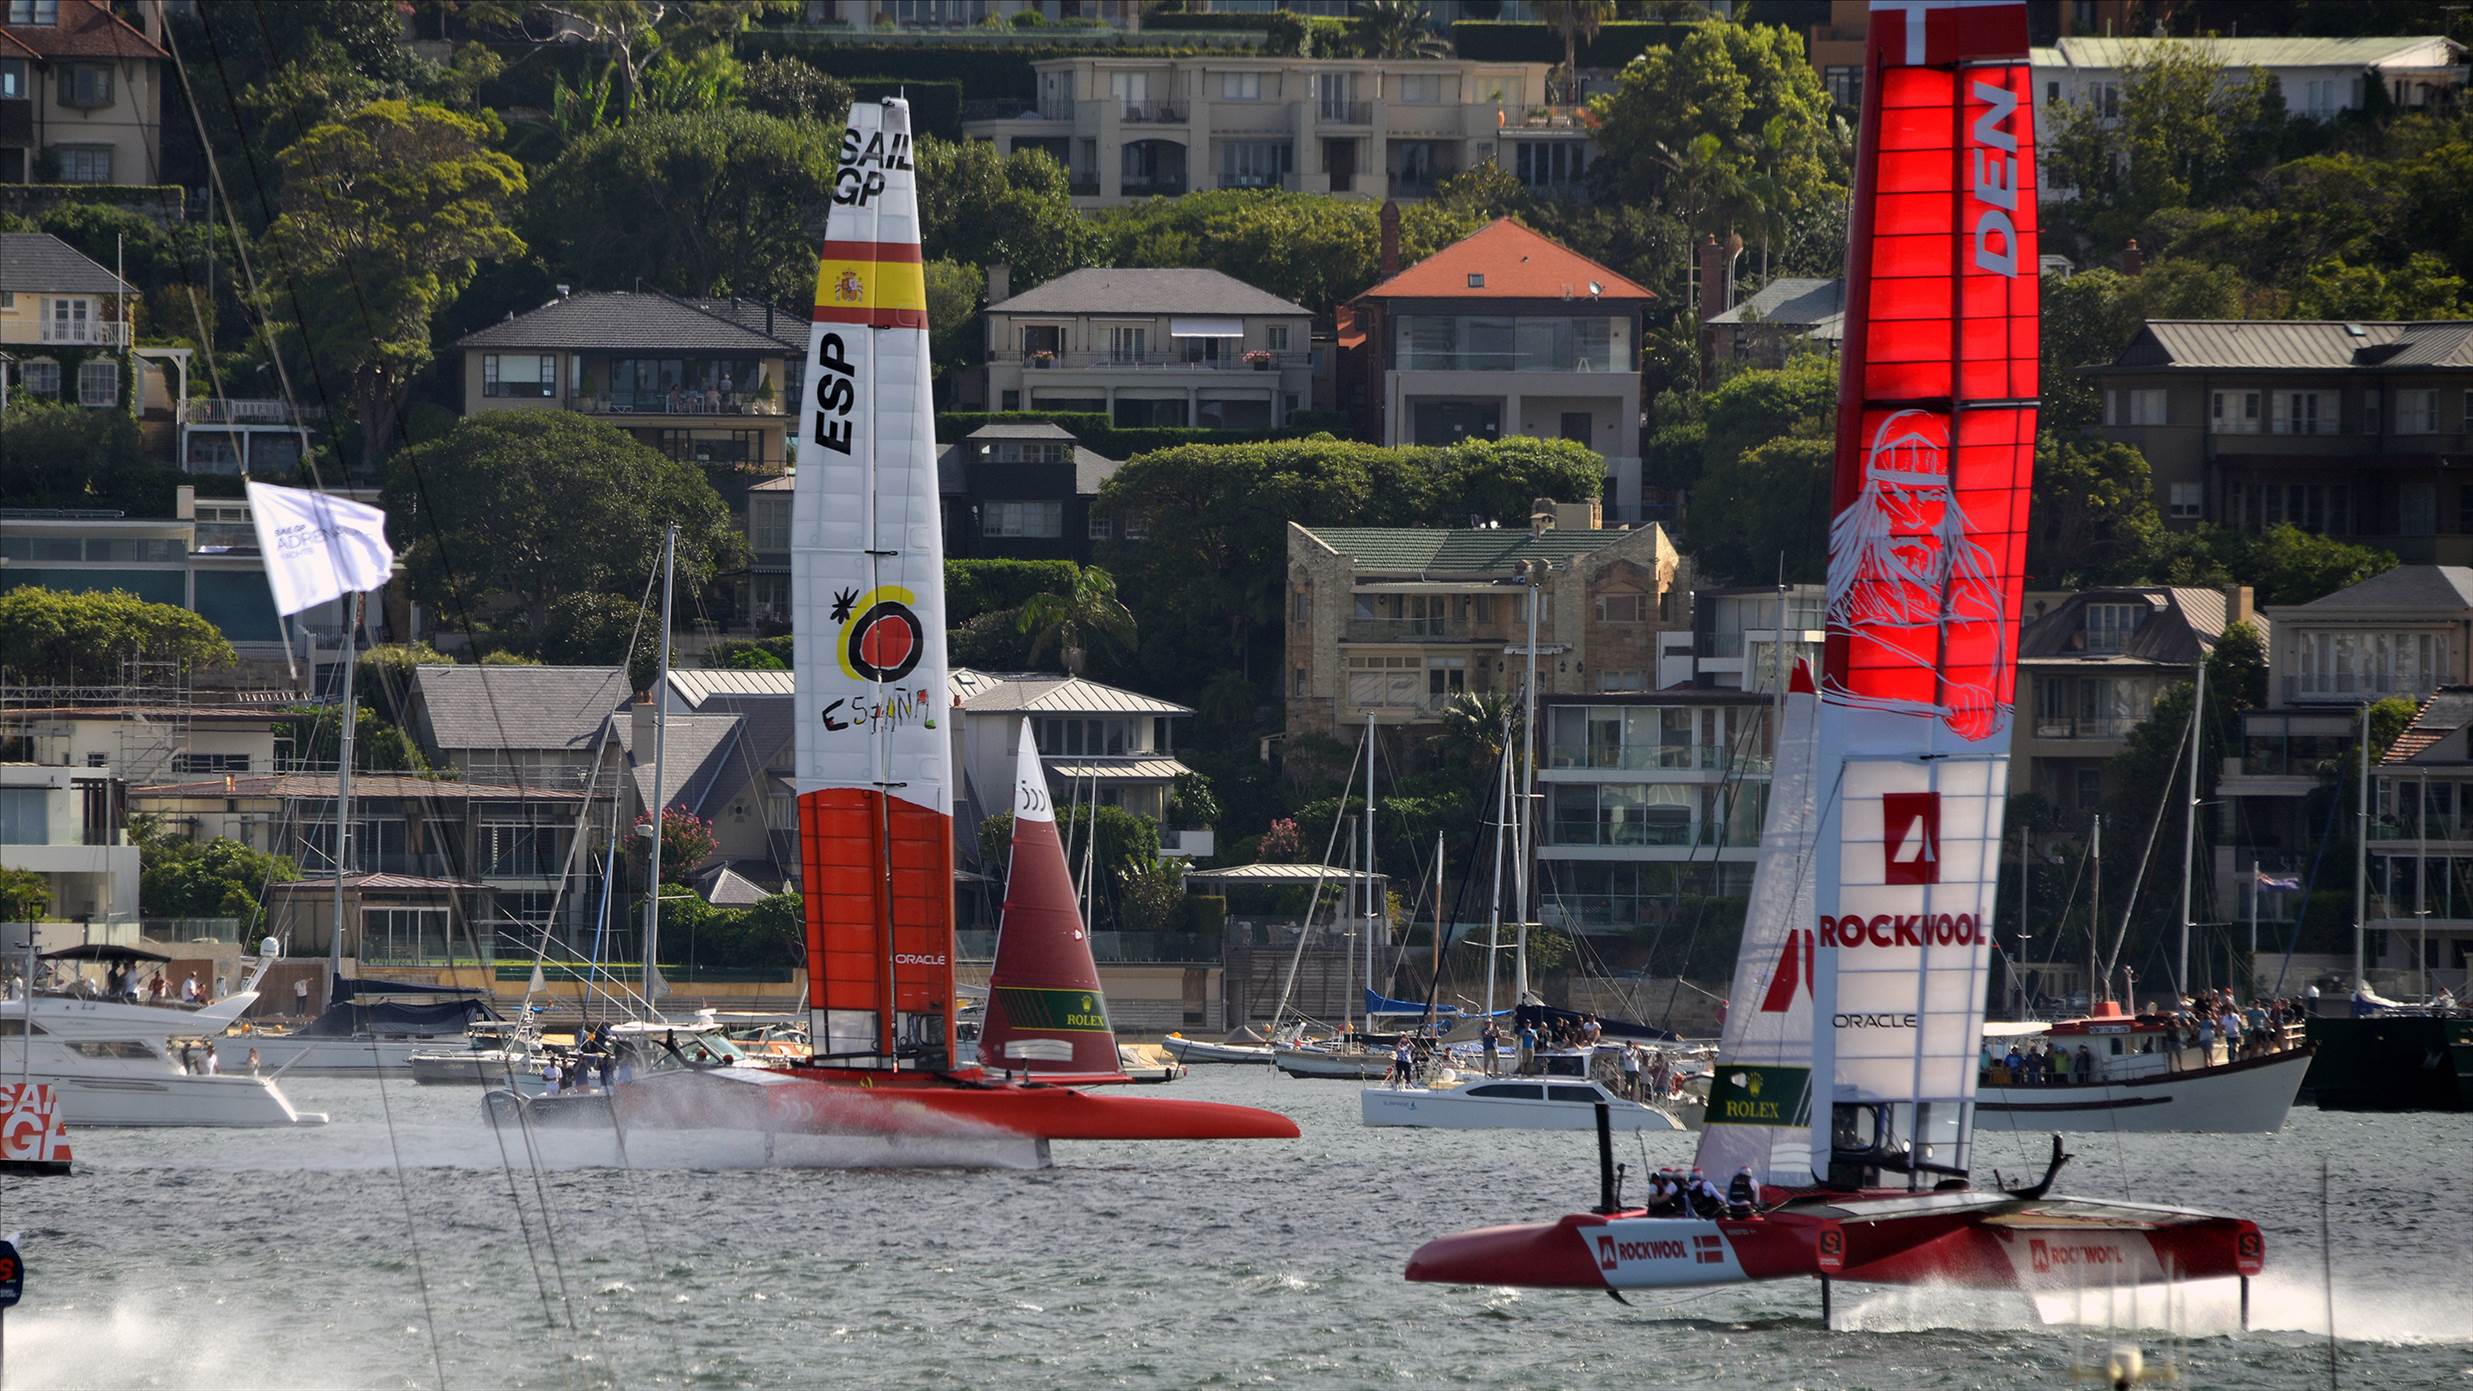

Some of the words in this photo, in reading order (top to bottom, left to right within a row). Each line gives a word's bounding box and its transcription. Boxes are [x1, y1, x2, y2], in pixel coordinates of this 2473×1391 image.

[839, 128, 913, 171] SAIL
[832, 168, 886, 207] GP
[1973, 80, 2017, 278] DEN
[815, 332, 855, 456] ESP
[1820, 912, 1985, 949] ROCKWOOL
[895, 953, 946, 966] ORACLE
[1066, 1013, 1105, 1027] ROLEX
[1832, 1013, 1918, 1029] ORACLE
[1726, 1101, 1780, 1119] ROLEX
[1617, 1239, 1689, 1261] ROCKWOOL
[2051, 1245, 2123, 1265] ROCWOL
